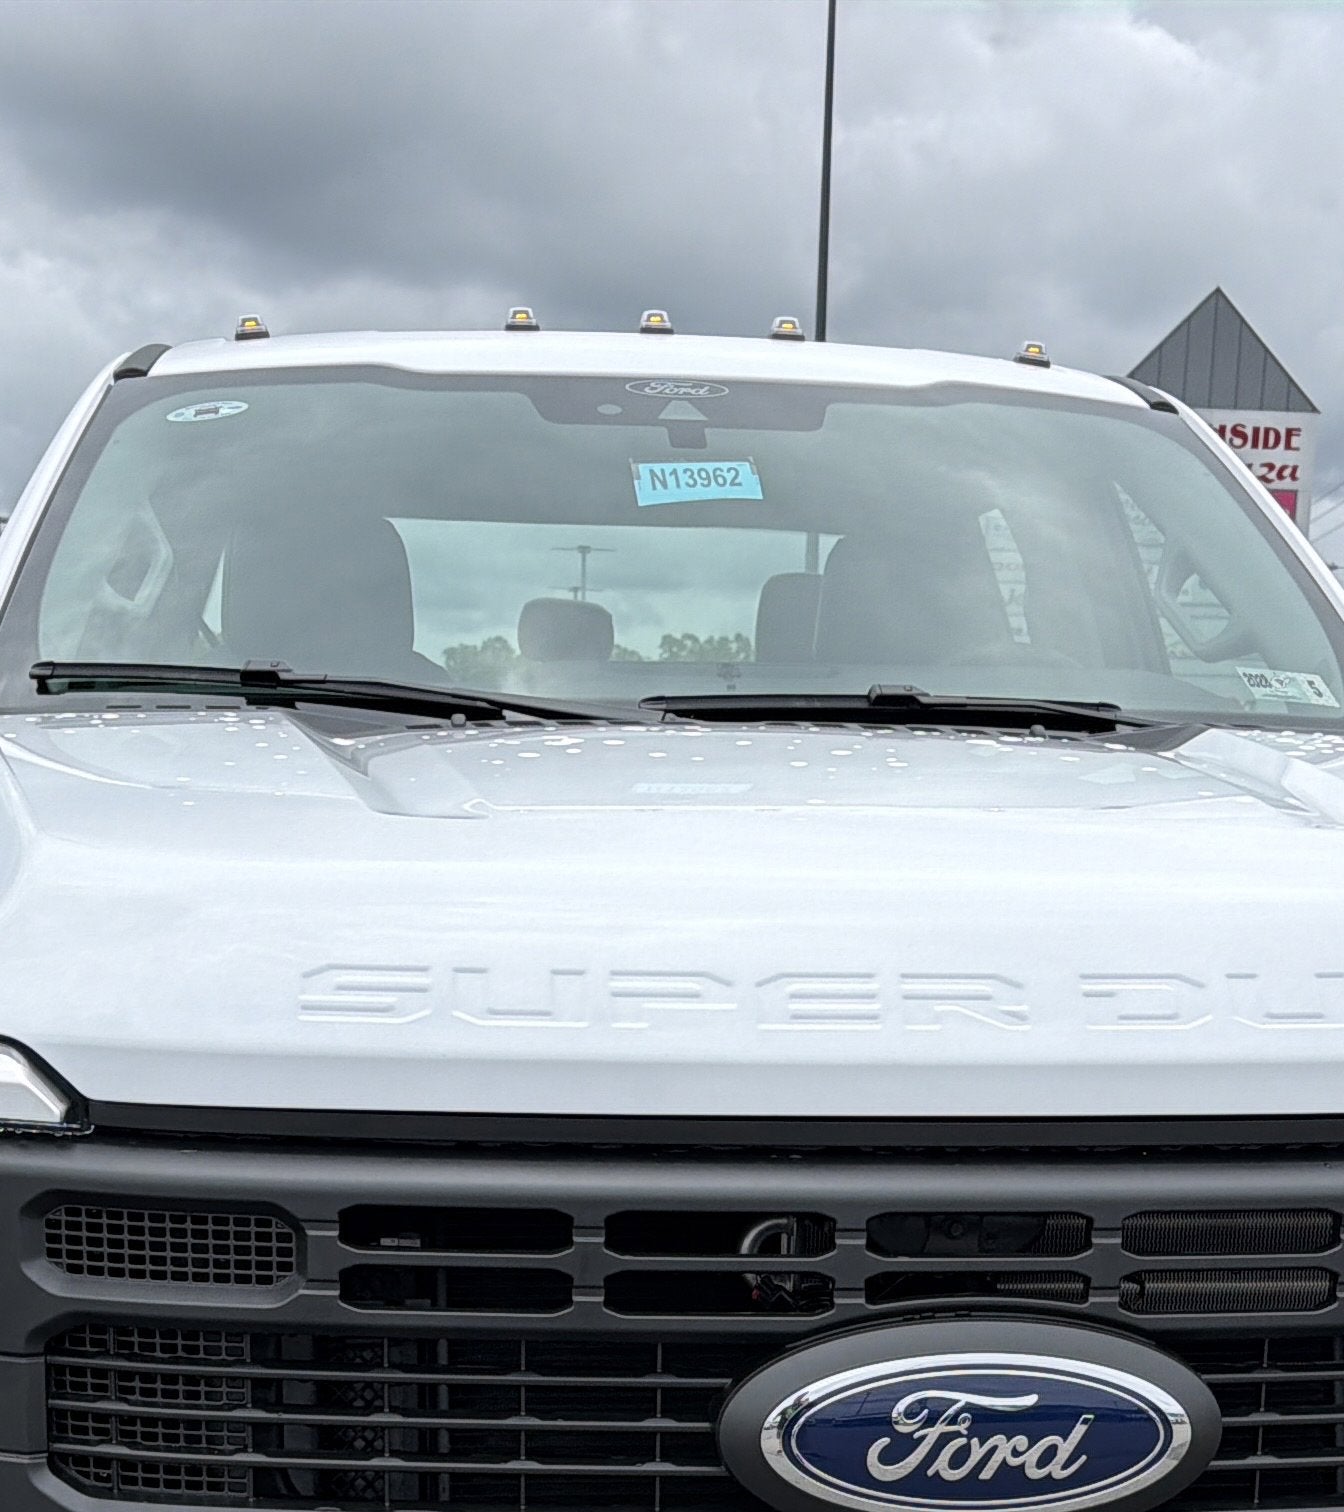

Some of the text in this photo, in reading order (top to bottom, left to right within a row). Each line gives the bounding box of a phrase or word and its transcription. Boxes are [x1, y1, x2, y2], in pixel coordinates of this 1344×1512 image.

[644, 381, 711, 396] Ford
[648, 466, 743, 491] N13962
[298, 964, 1031, 1030] SUPER
[867, 1390, 1094, 1482] Ford
